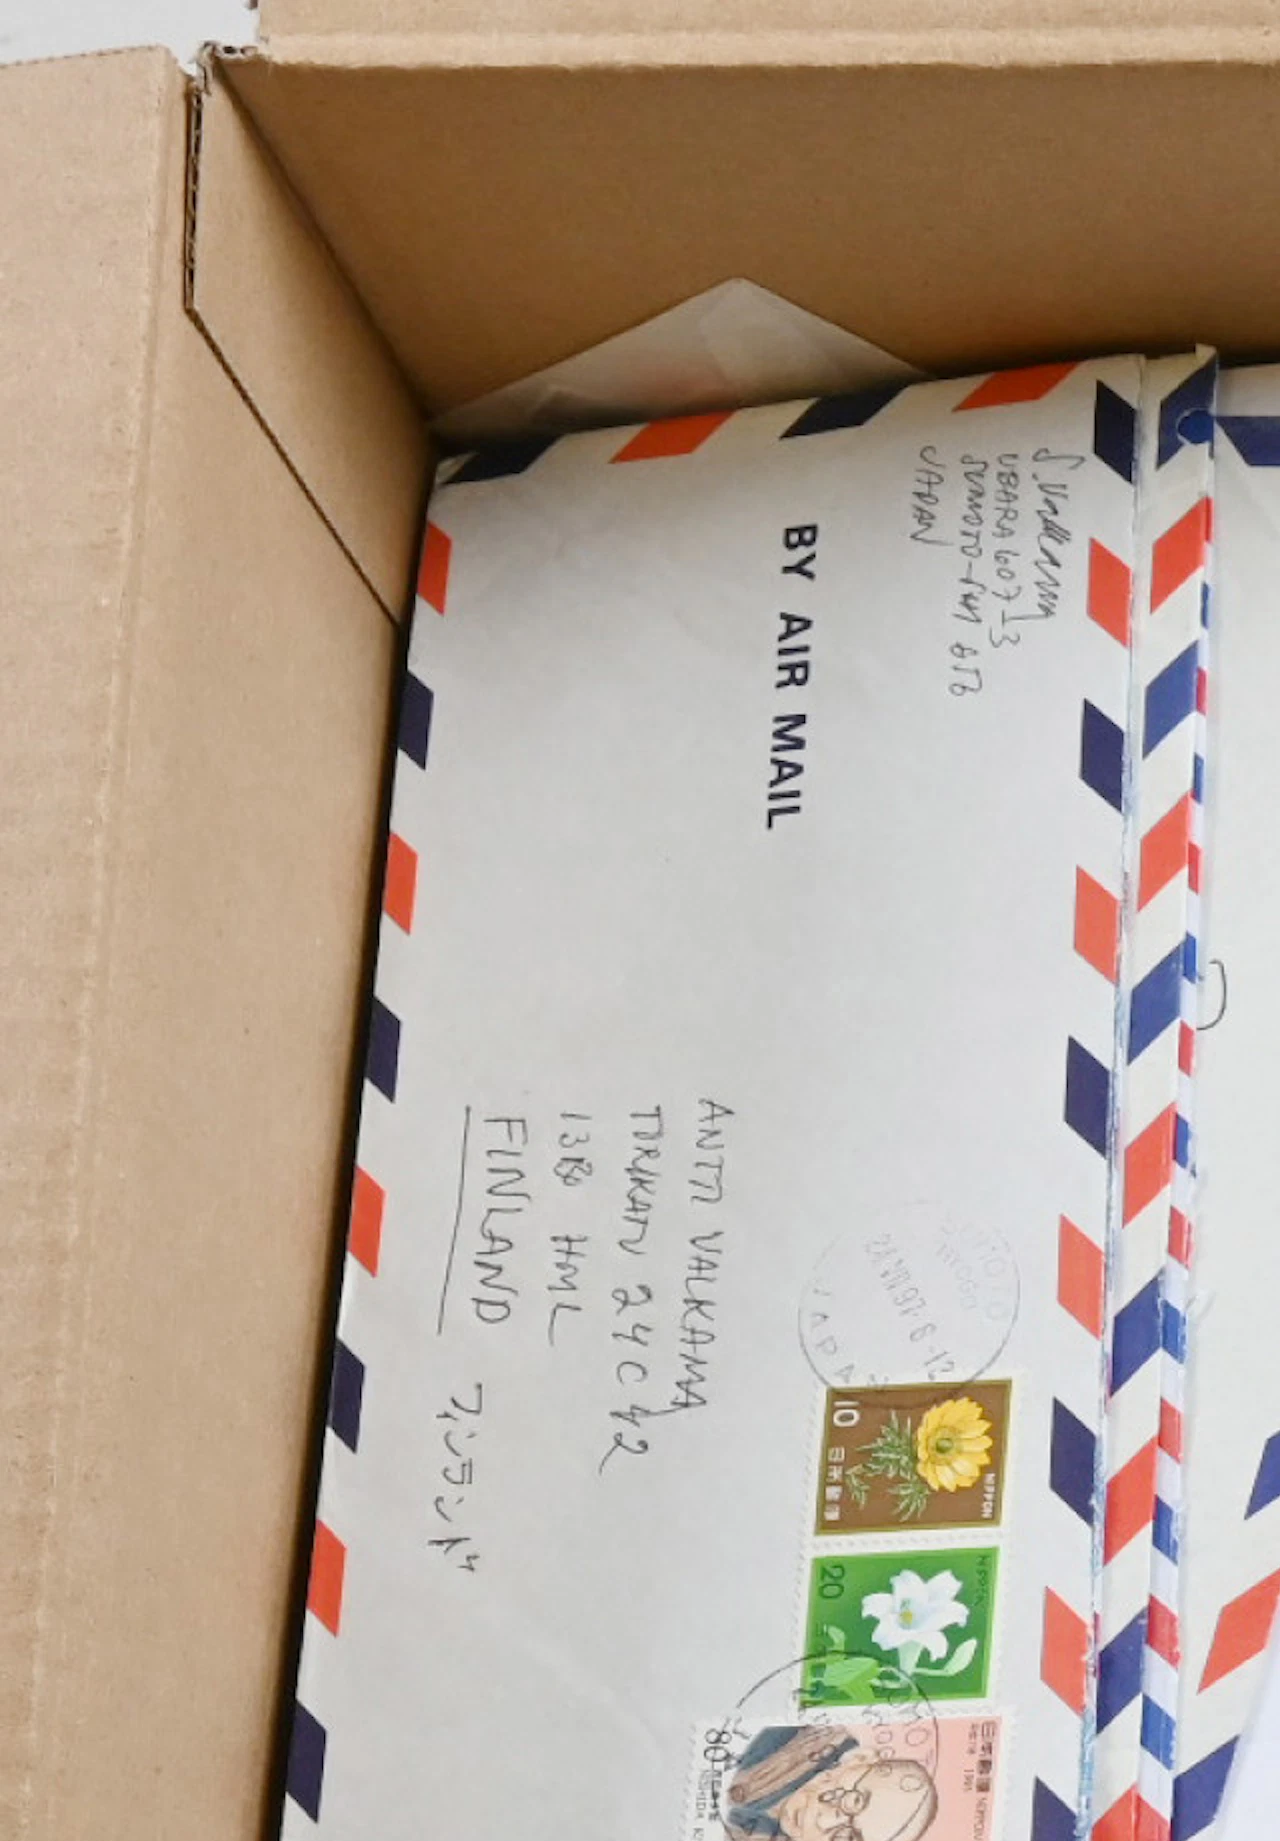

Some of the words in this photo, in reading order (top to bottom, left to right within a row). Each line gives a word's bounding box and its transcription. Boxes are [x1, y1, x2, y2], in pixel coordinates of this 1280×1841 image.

[781, 524, 818, 582] BY
[775, 612, 814, 690] AIR
[766, 713, 807, 831] MAIL
[472, 1117, 532, 1325] FINLAND
[665, 1230, 724, 1414] VALKAMA
[832, 1400, 860, 1428] 10
[818, 1562, 847, 1601] 20
[703, 1727, 733, 1763] 80
